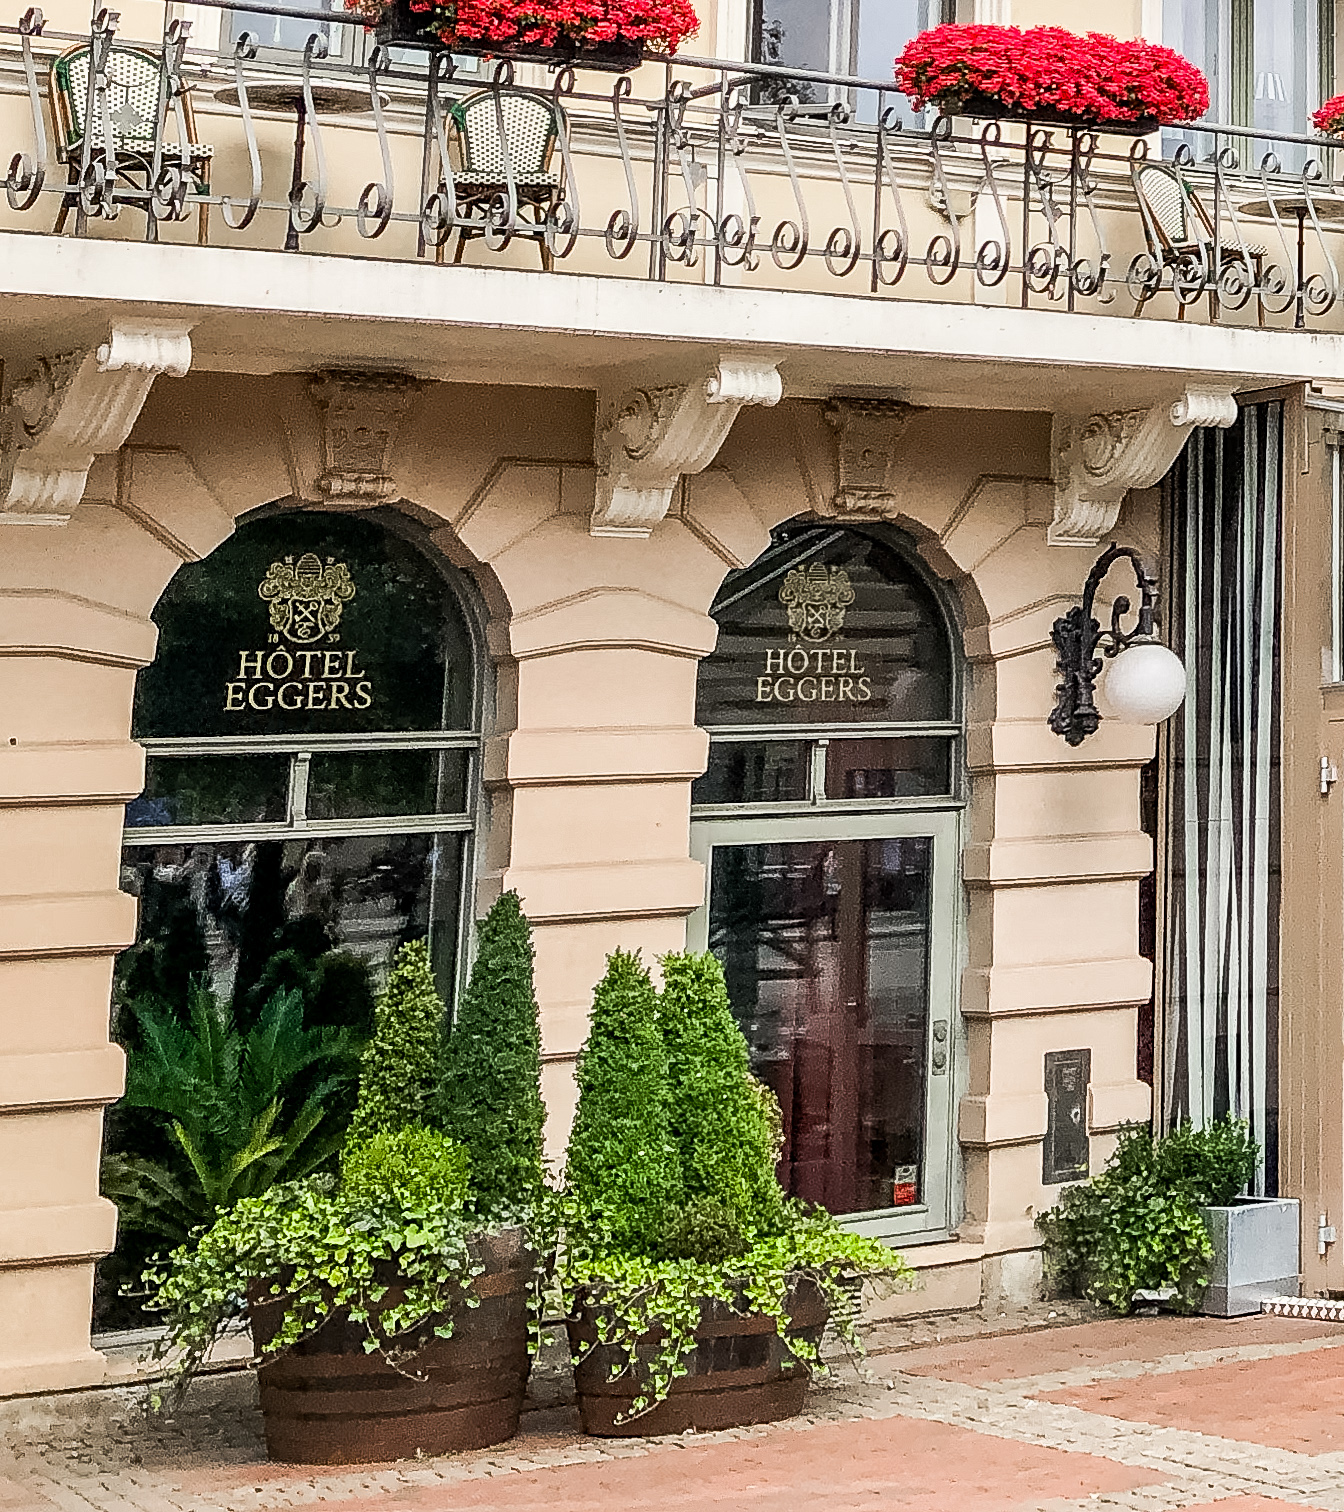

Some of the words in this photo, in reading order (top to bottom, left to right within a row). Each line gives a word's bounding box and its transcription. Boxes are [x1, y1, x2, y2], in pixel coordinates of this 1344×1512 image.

[236, 644, 366, 679] HÔTEL
[764, 644, 866, 674] HÔTEL
[223, 681, 373, 712] EGGERS
[755, 676, 872, 703] EGGERS
